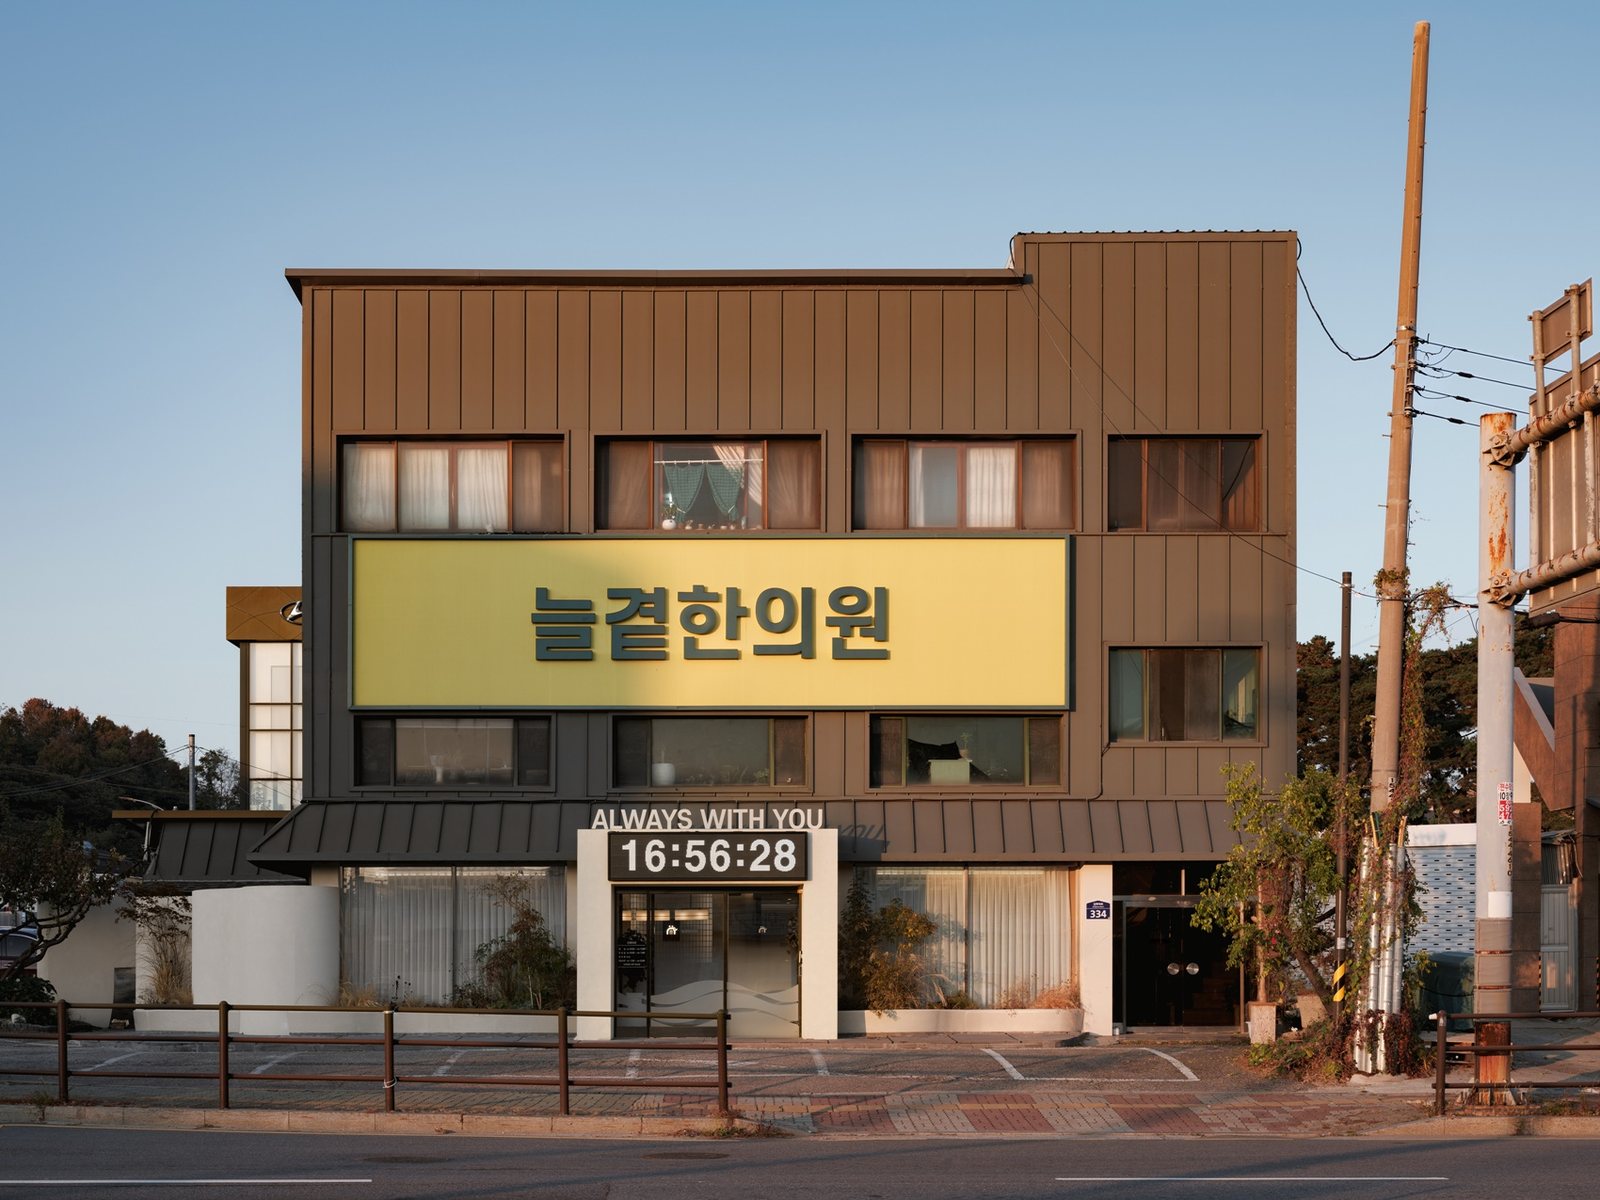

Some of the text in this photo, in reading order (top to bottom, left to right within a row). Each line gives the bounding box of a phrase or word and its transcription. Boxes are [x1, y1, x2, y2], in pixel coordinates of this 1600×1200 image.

[532, 584, 890, 661] 늘곁한의원
[591, 808, 824, 830] ALWAYS WITH YOU
[621, 838, 797, 873] 16:56:28
[1090, 910, 1107, 919] 334
